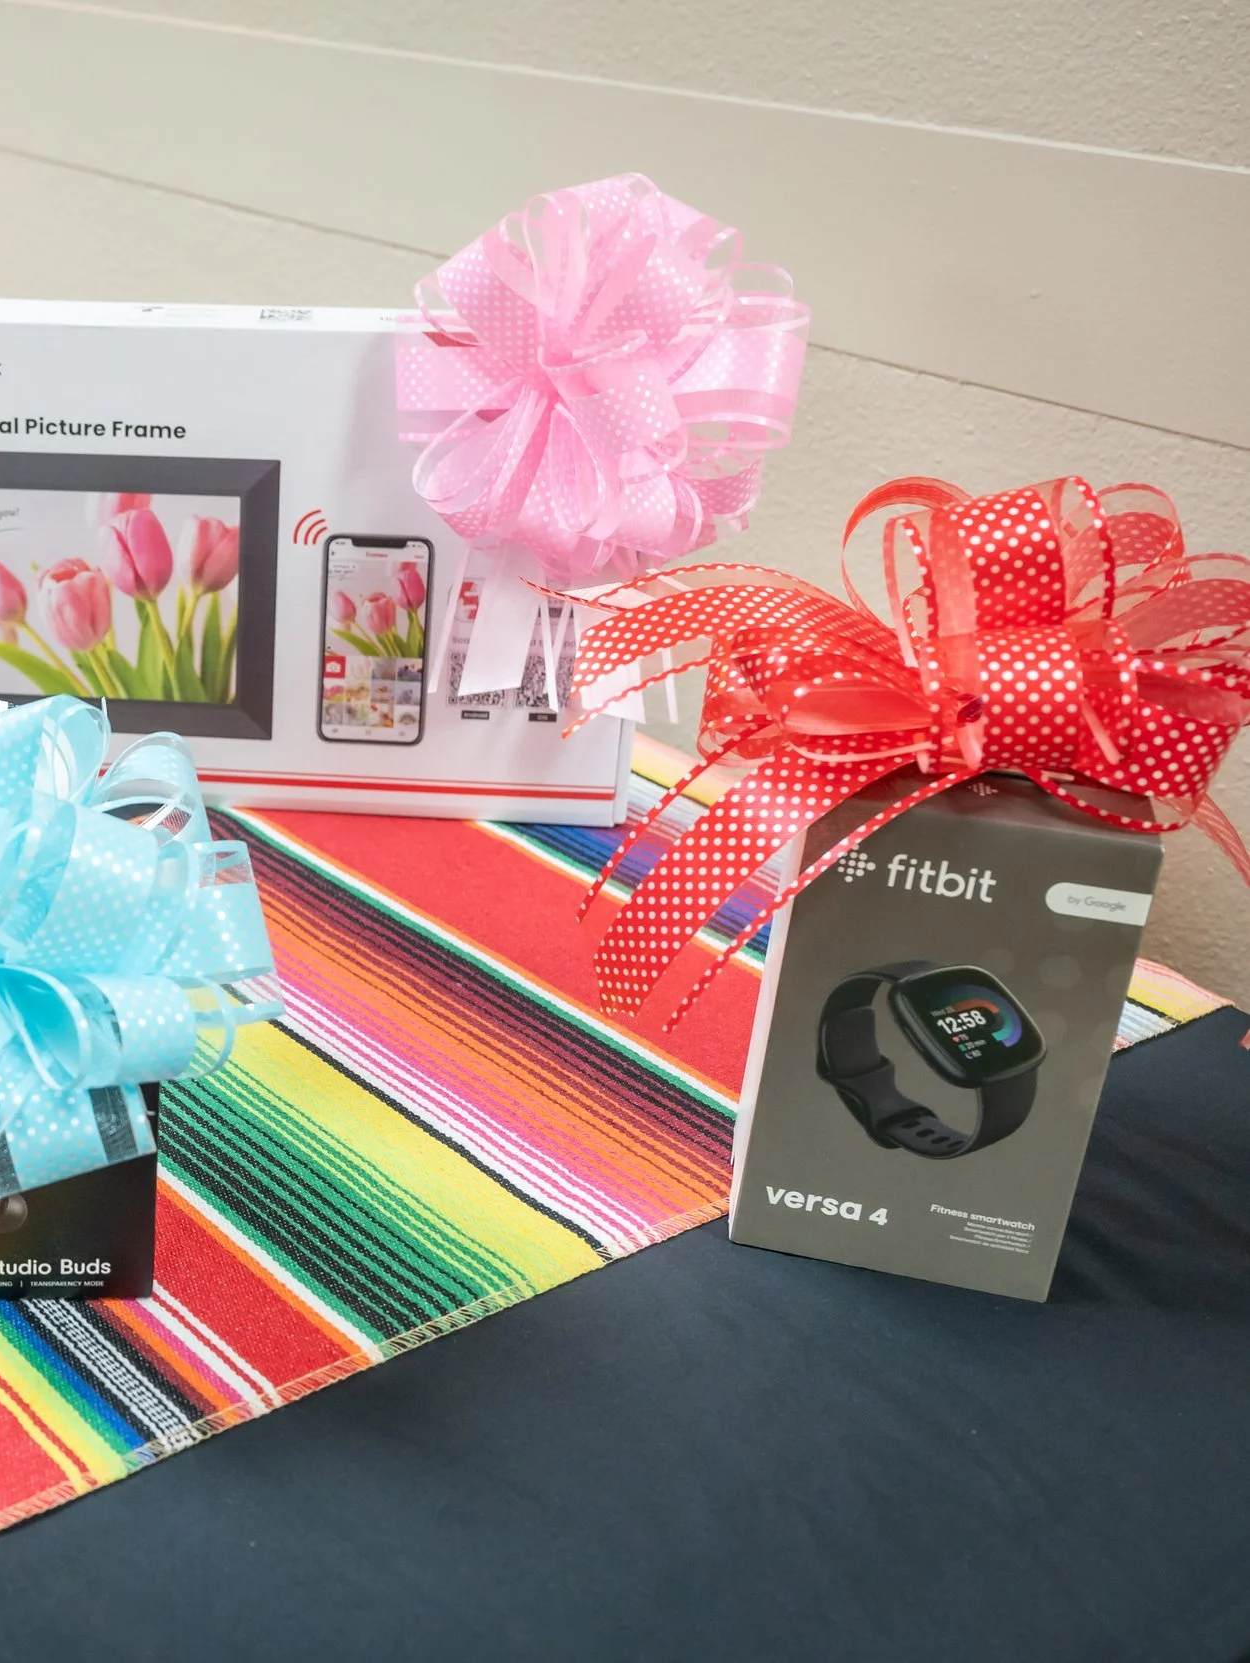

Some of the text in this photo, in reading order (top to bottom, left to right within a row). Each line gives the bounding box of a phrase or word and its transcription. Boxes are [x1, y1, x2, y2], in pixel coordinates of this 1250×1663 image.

[26, 417, 105, 436] Picture
[113, 421, 186, 438] Frame
[888, 854, 996, 903] fitbit
[1067, 895, 1126, 912] by Google
[936, 1010, 987, 1034] 12:58
[767, 1186, 887, 1225] versa 4
[930, 1204, 968, 1218] Fitness
[970, 1214, 1036, 1231] smartwatch
[60, 1258, 111, 1275] Buds
